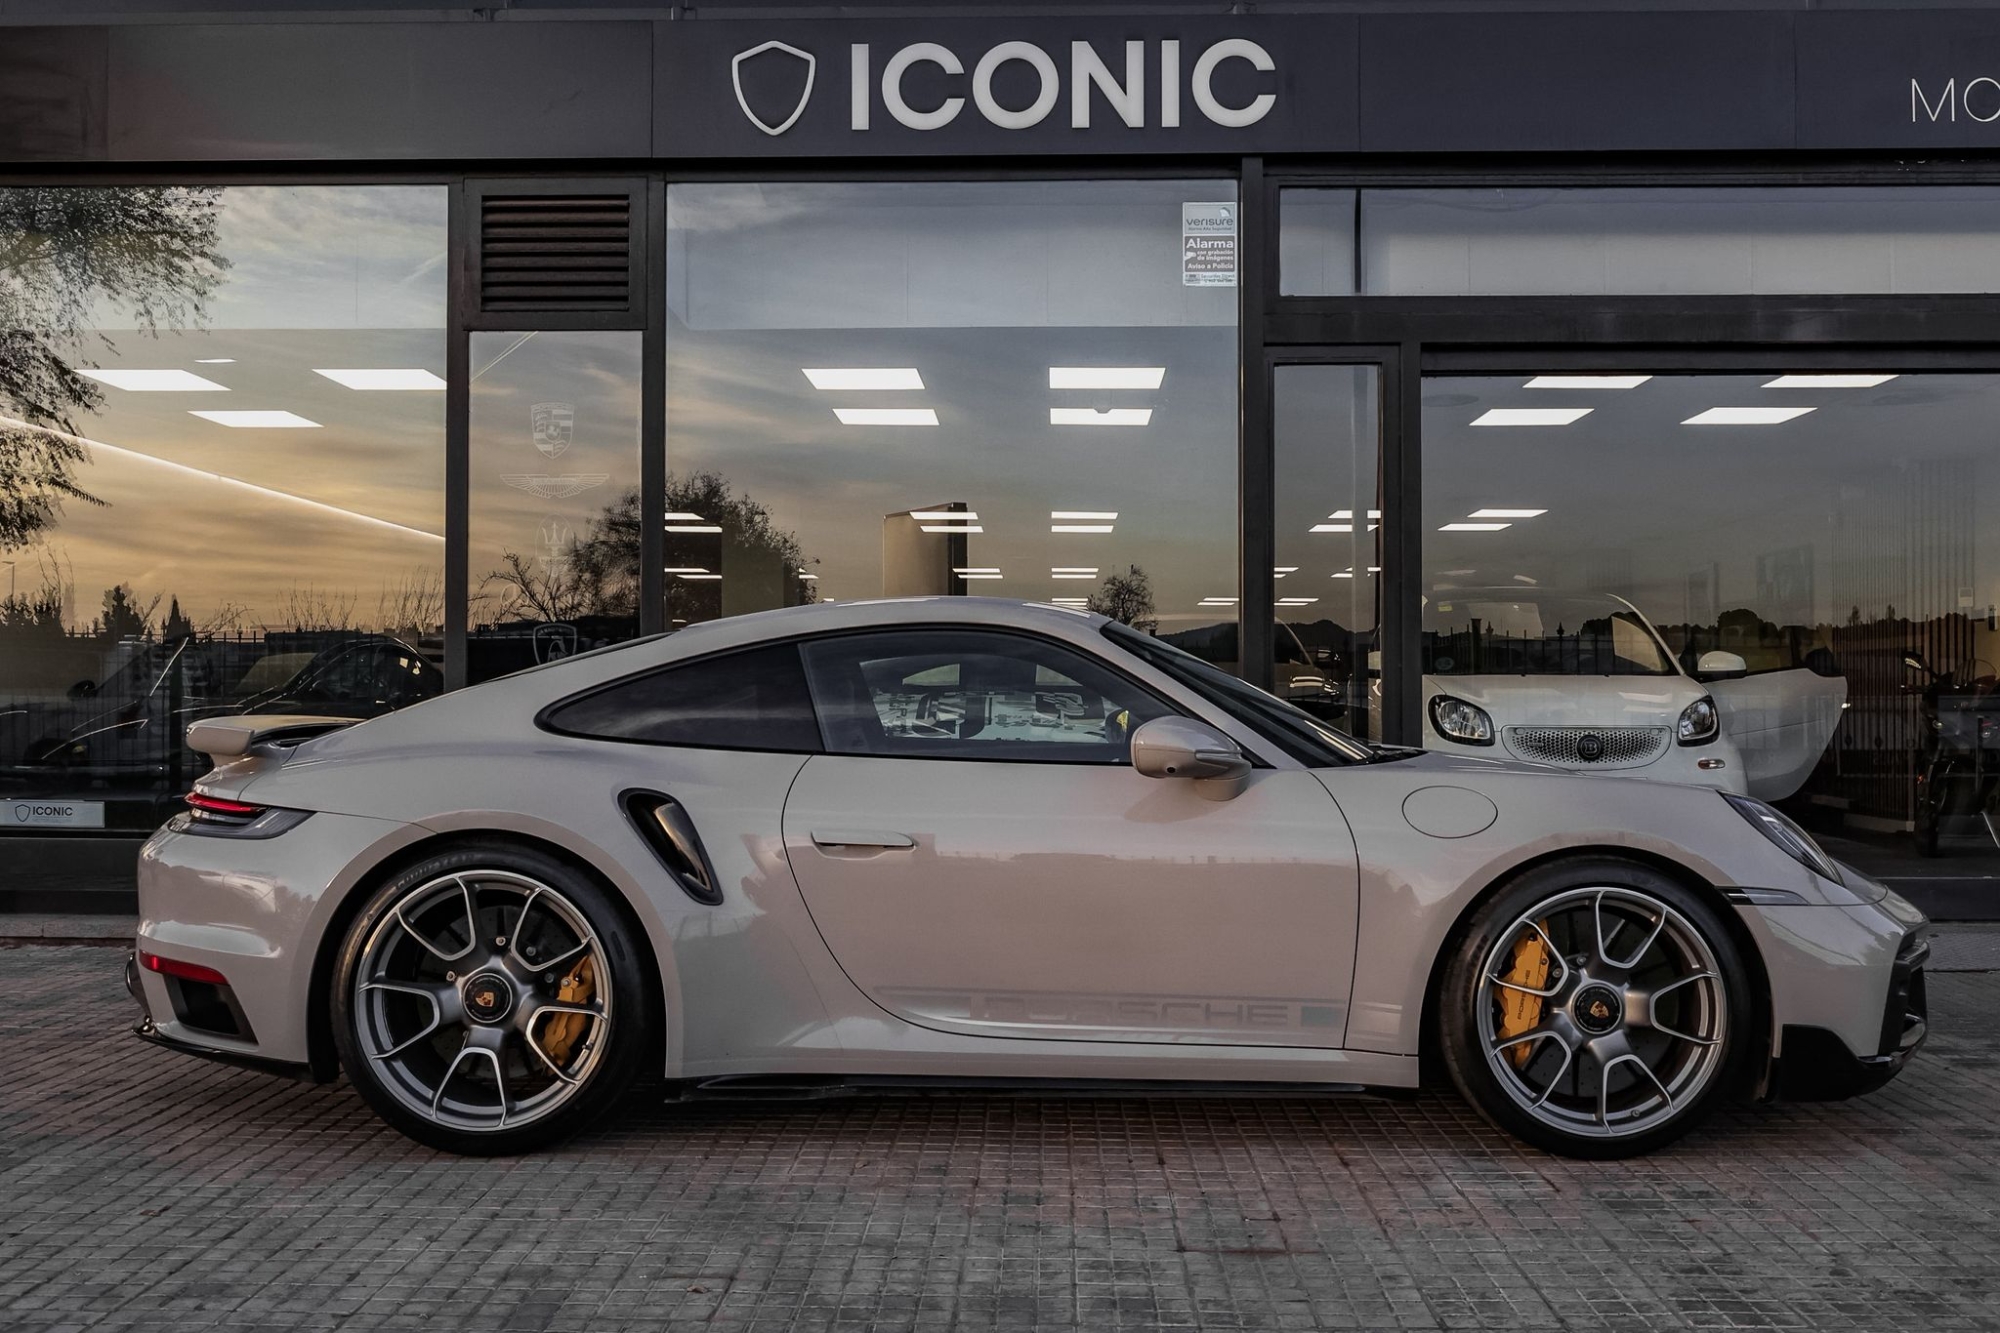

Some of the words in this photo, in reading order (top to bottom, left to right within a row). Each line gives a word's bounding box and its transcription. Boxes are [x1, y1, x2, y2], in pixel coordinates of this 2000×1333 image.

[851, 38, 1276, 130] ICONIC
[1186, 218, 1234, 226] verisure
[1186, 237, 1234, 249] Alarma
[1584, 741, 1598, 753] B
[32, 806, 73, 816] ICONIC
